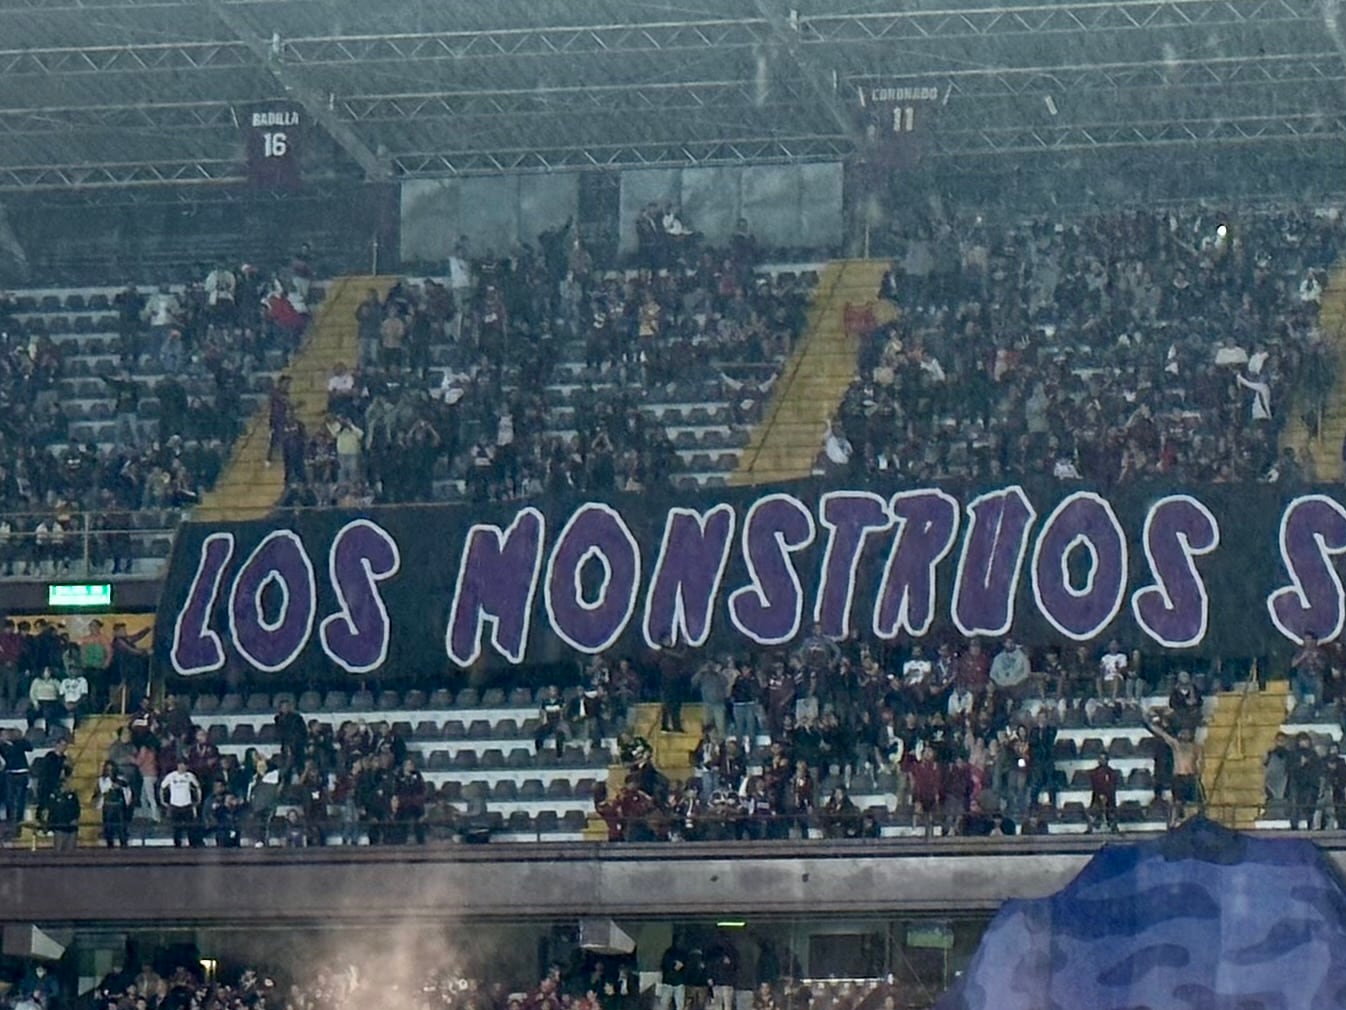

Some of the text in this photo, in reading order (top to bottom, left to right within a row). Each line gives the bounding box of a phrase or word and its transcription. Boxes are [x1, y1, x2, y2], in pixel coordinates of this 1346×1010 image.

[252, 111, 299, 127] BADILLA
[894, 106, 914, 131] 11
[264, 132, 287, 157] 16
[171, 519, 400, 676] LOS
[446, 484, 1220, 668] MONSTRUOS
